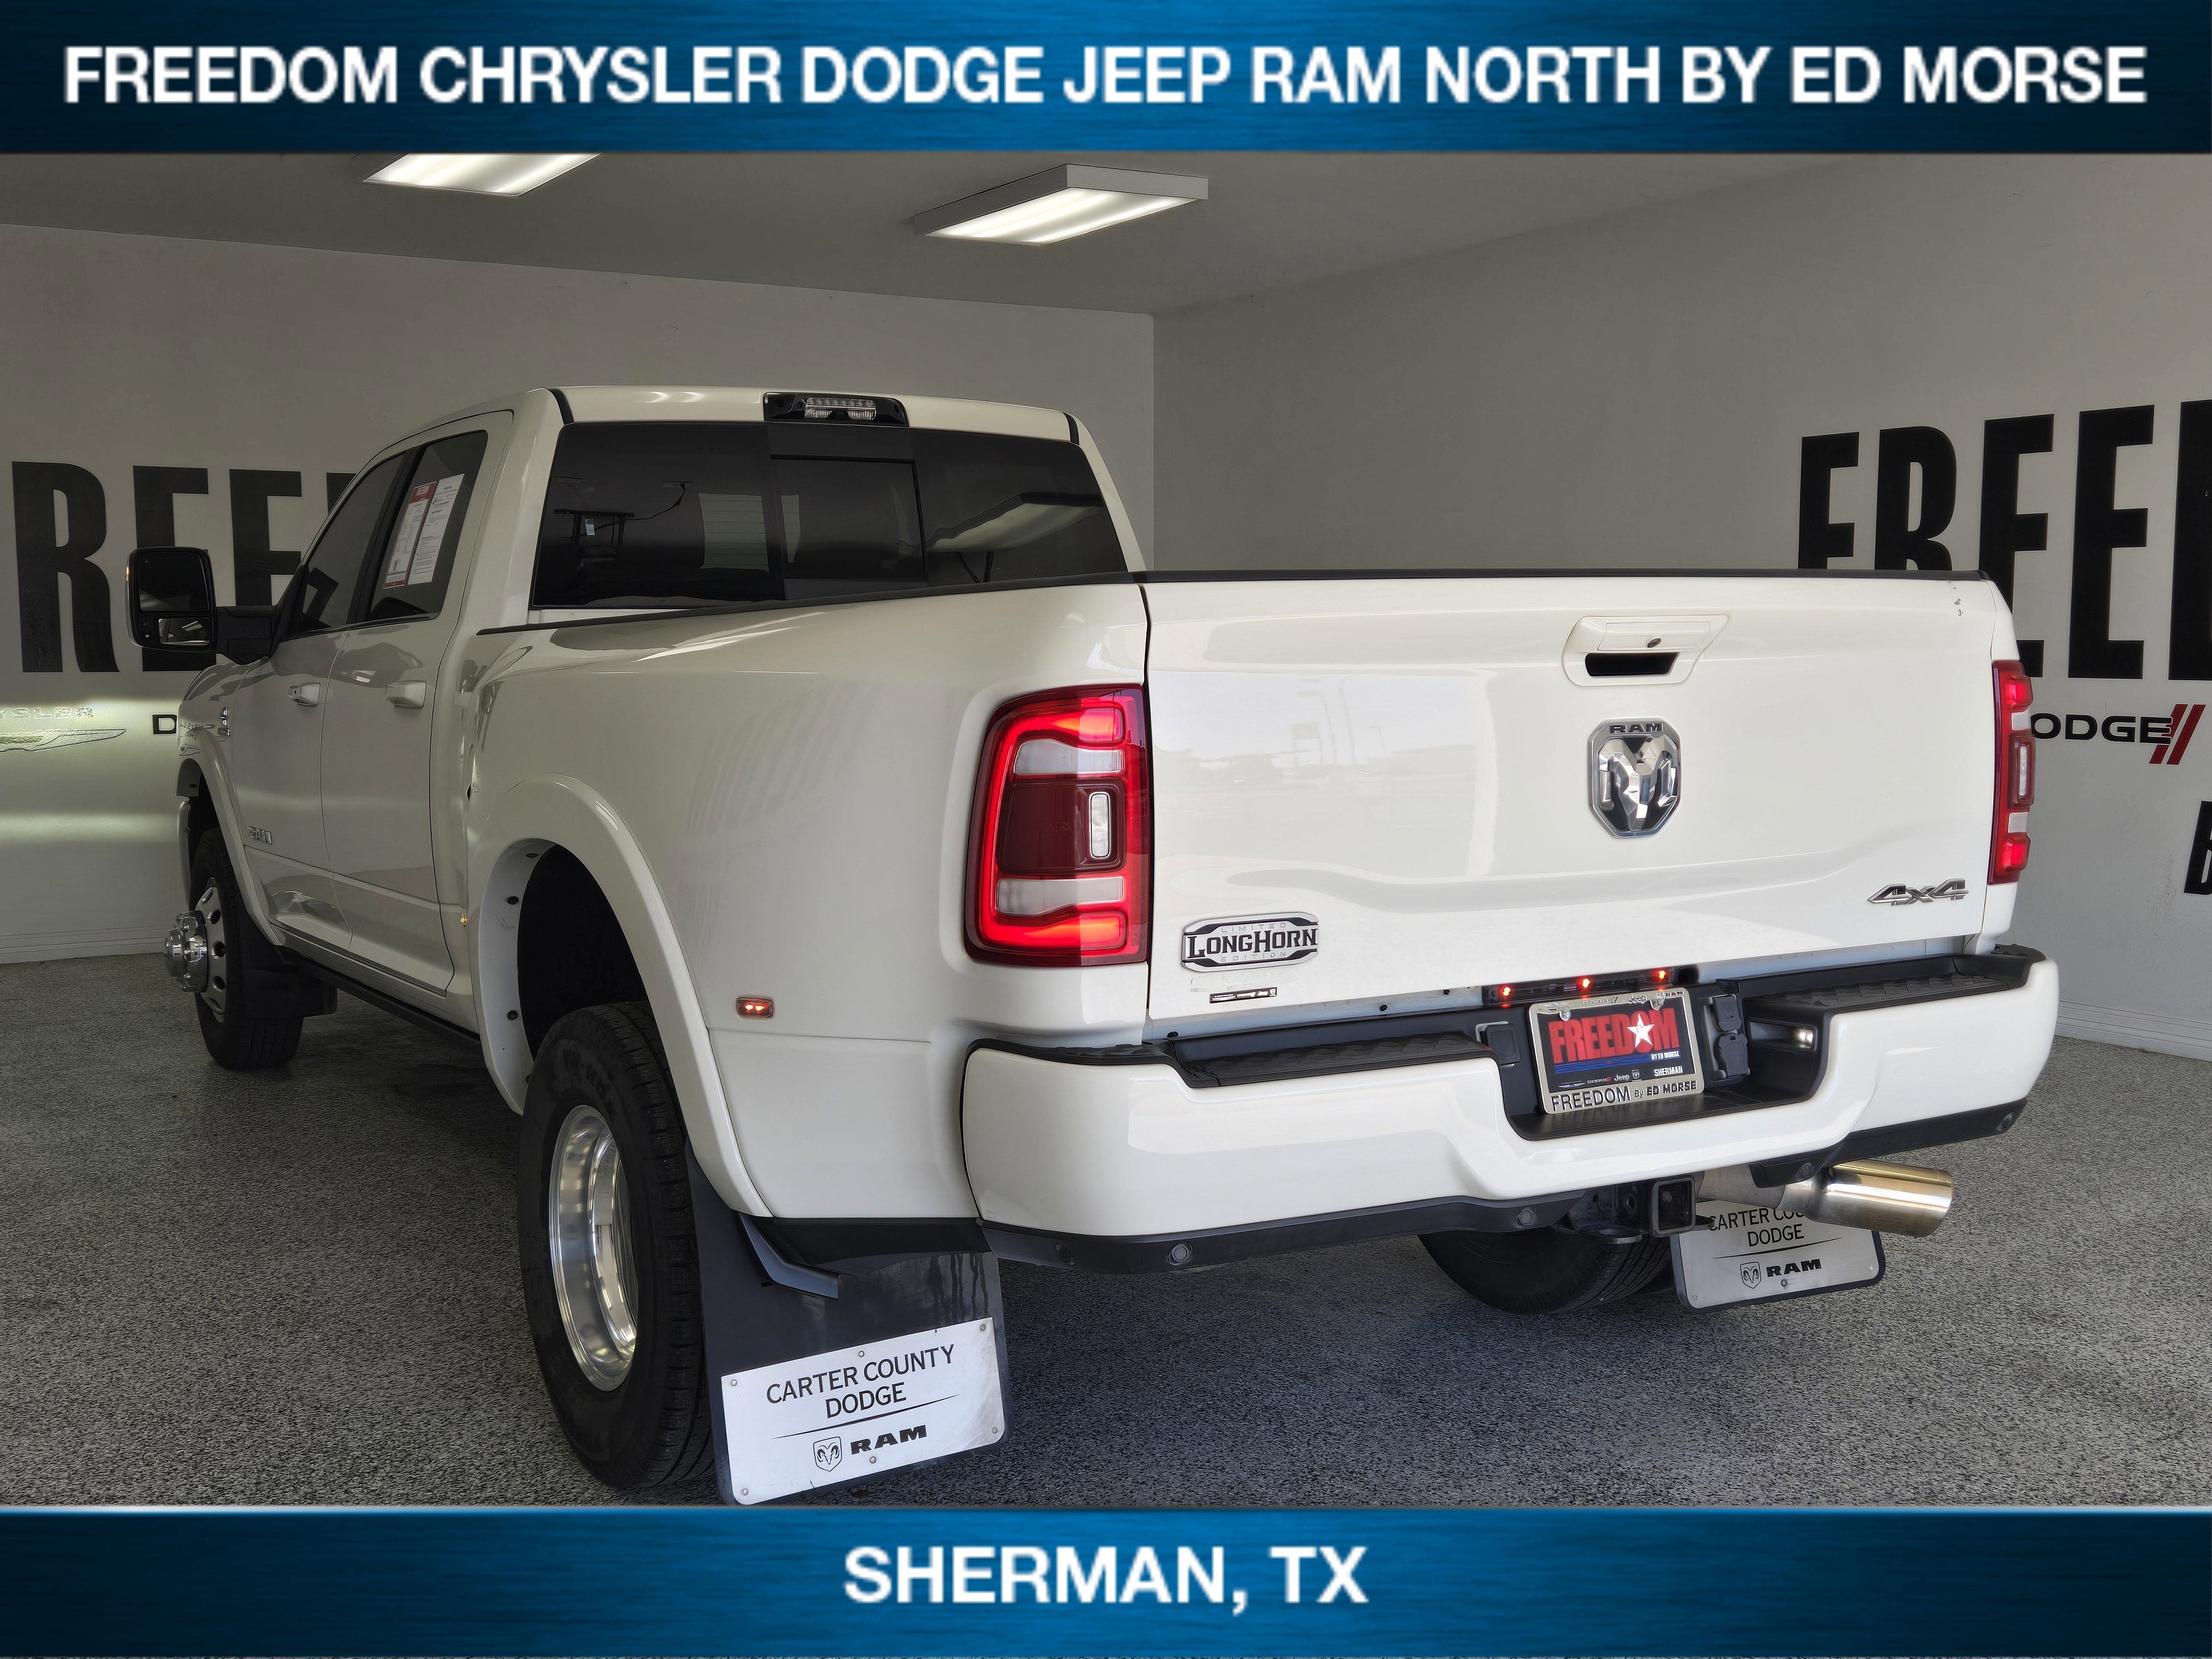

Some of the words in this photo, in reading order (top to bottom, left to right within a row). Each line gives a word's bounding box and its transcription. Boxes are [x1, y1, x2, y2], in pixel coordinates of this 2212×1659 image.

[12, 461, 357, 673] REE
[1610, 723, 1664, 734] RAM
[1221, 922, 1287, 932] LIMITED
[1220, 951, 1287, 962] EDITION
[1549, 1007, 1680, 1064] FREEDOM
[1653, 1066, 1683, 1077] SHERMAN
[1551, 1086, 1631, 1112] FREEDOM
[1647, 1086, 1659, 1096] ED
[1662, 1080, 1697, 1094] MORSE
[1747, 1223, 1804, 1247] DODGE
[1766, 1259, 1822, 1277] RAM
[766, 1365, 857, 1404] CARTER
[863, 1344, 955, 1381] COUNTY
[826, 1381, 907, 1419] DODGE
[850, 1425, 927, 1455] RAM
